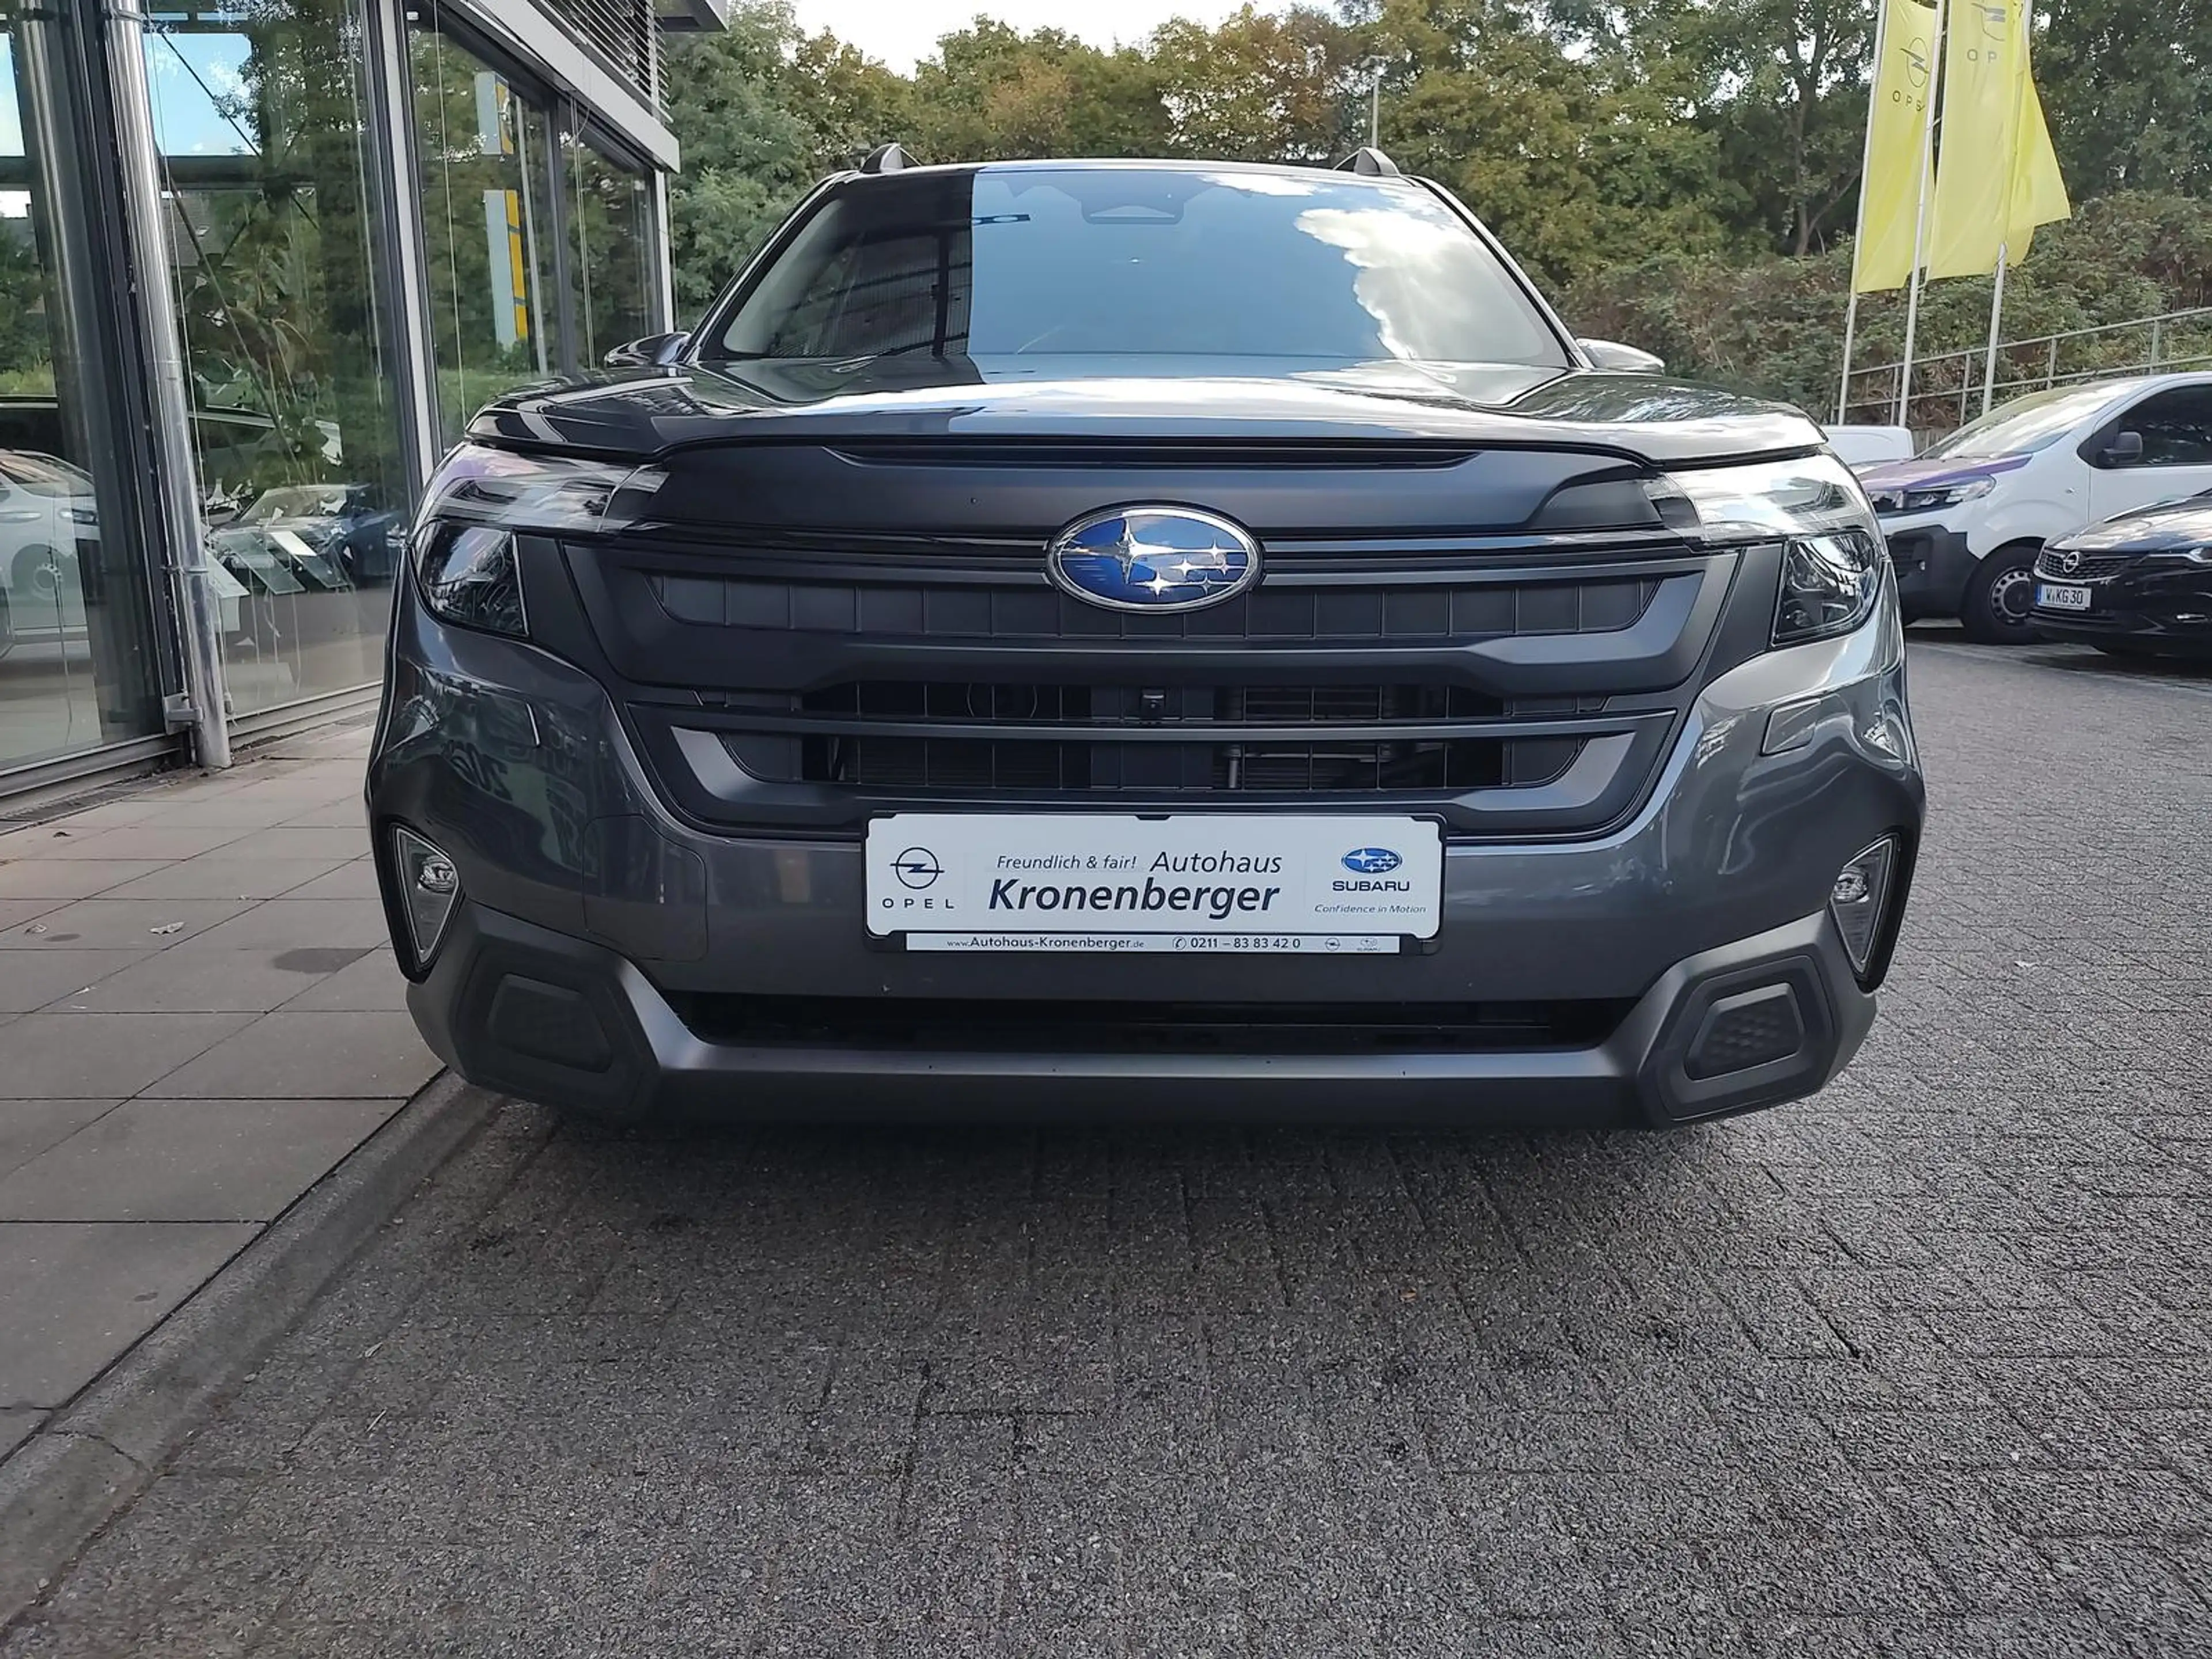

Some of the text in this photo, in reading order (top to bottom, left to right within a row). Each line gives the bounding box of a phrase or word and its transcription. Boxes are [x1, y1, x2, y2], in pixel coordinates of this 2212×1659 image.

[997, 850, 1283, 874] Freundlich & fair! Autohaus
[1332, 880, 1411, 892] SUBARU
[882, 897, 955, 910] OPEL
[987, 877, 1282, 921] Kronenberger
[1315, 904, 1427, 914] Confidence in Motion
[946, 936, 1145, 950] www.Autohaus-Kronenberger.de
[1190, 937, 1218, 949] 0211
